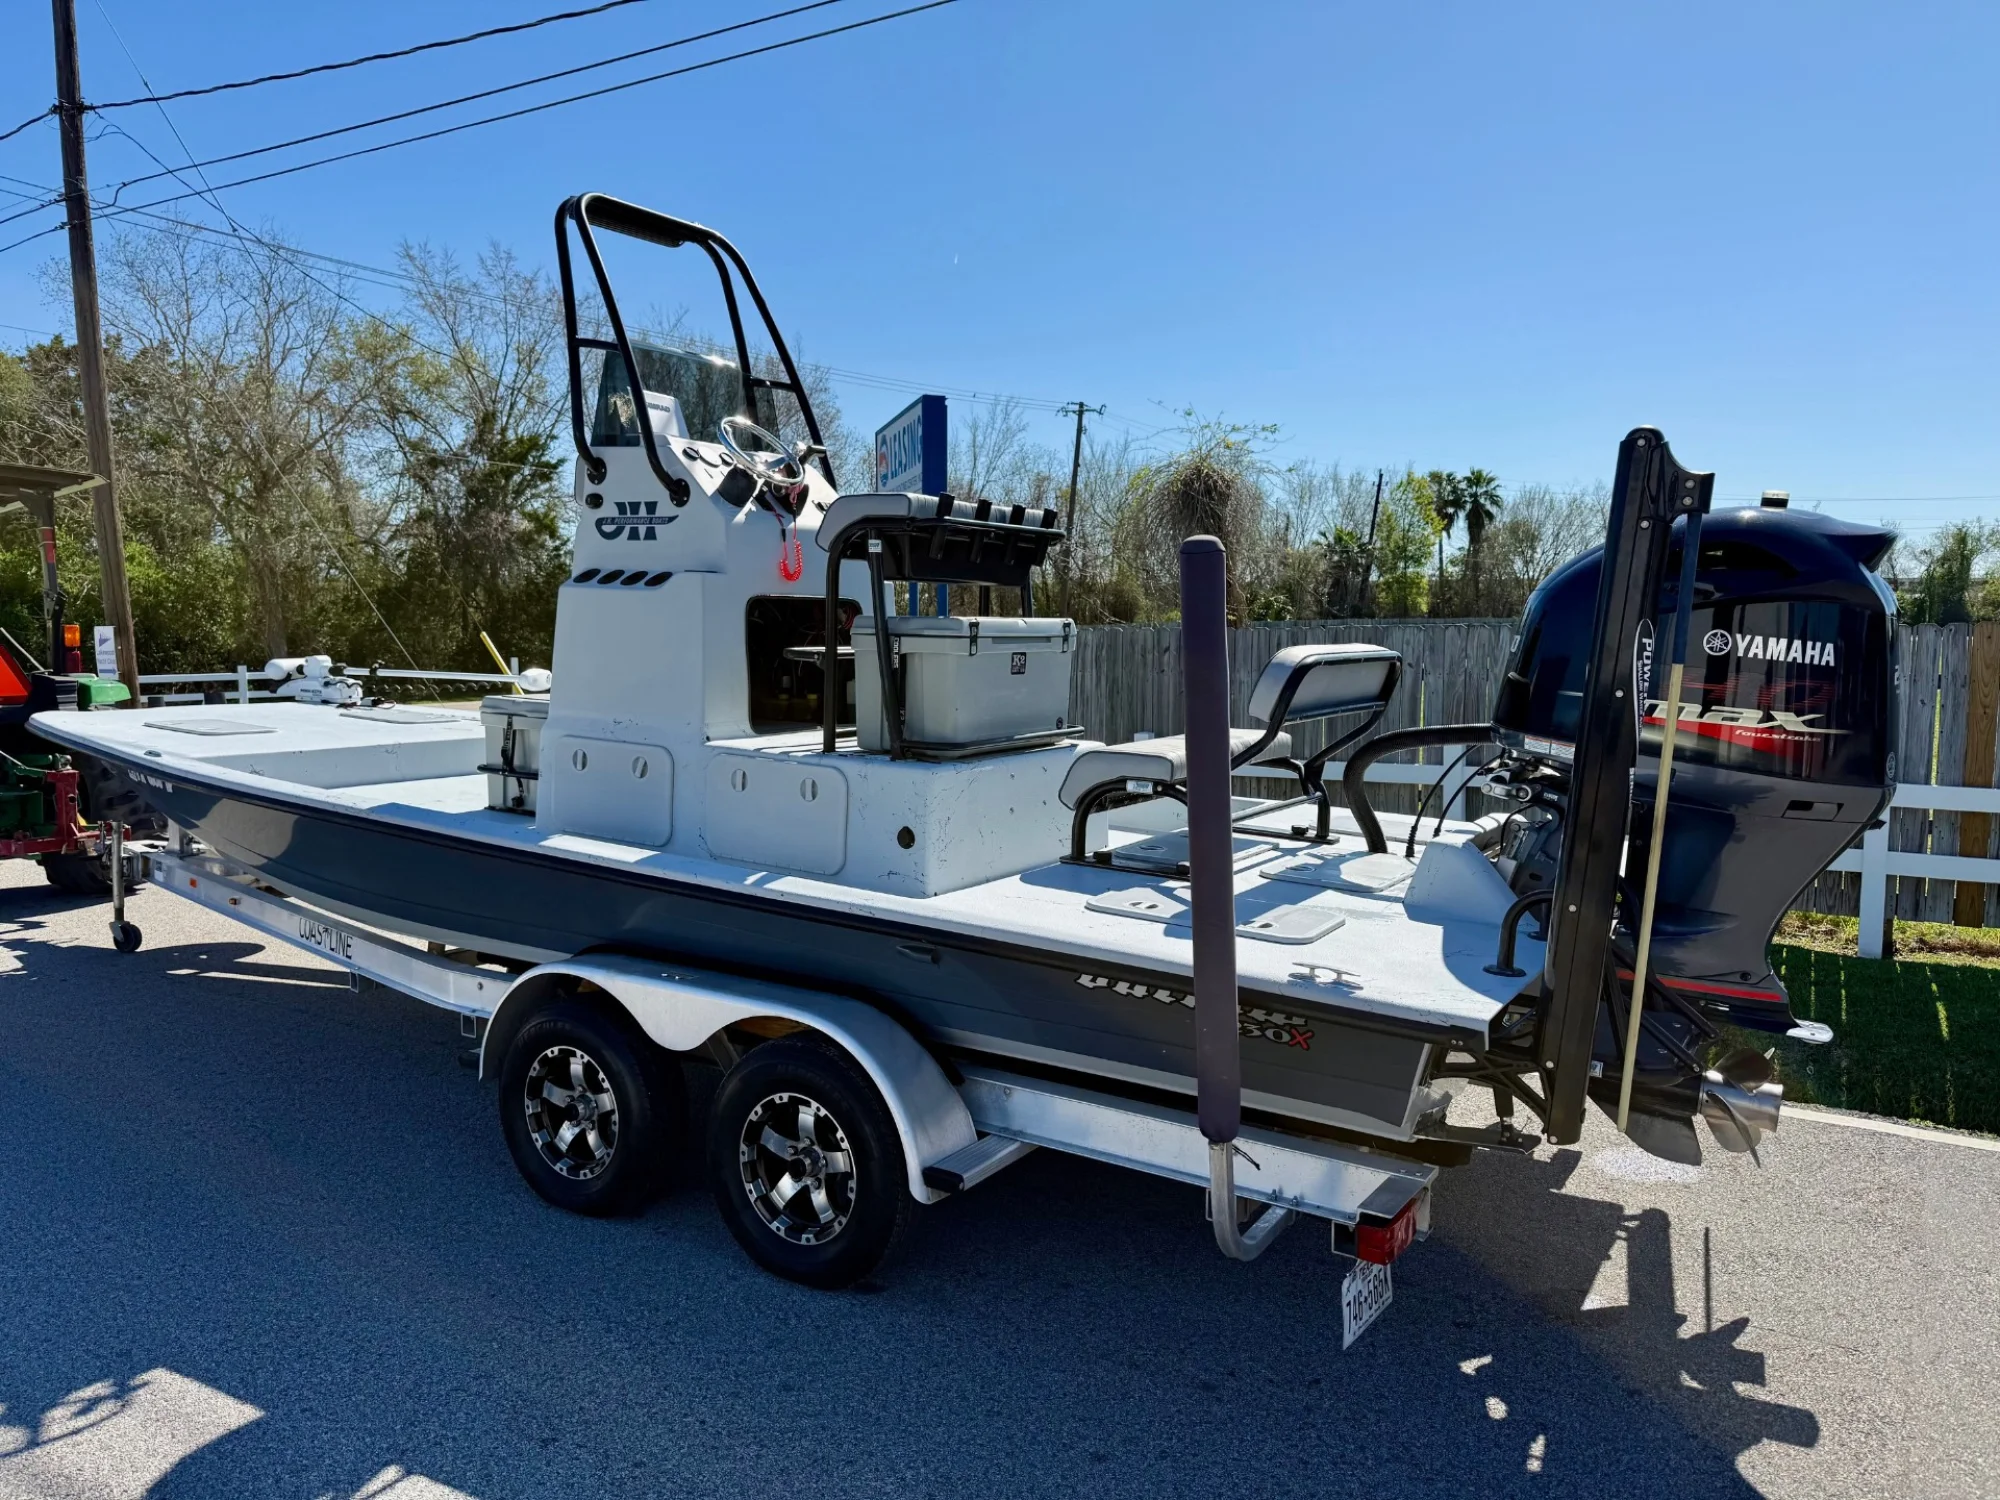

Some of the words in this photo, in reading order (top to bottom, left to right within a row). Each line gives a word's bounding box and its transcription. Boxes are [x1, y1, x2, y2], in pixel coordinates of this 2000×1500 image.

[889, 415, 922, 480] LEASING
[614, 517, 650, 525] PERFORMANCE
[1012, 655, 1026, 666] K2
[1736, 633, 1836, 667] YAMAHA
[1237, 1022, 1315, 1051] 30X
